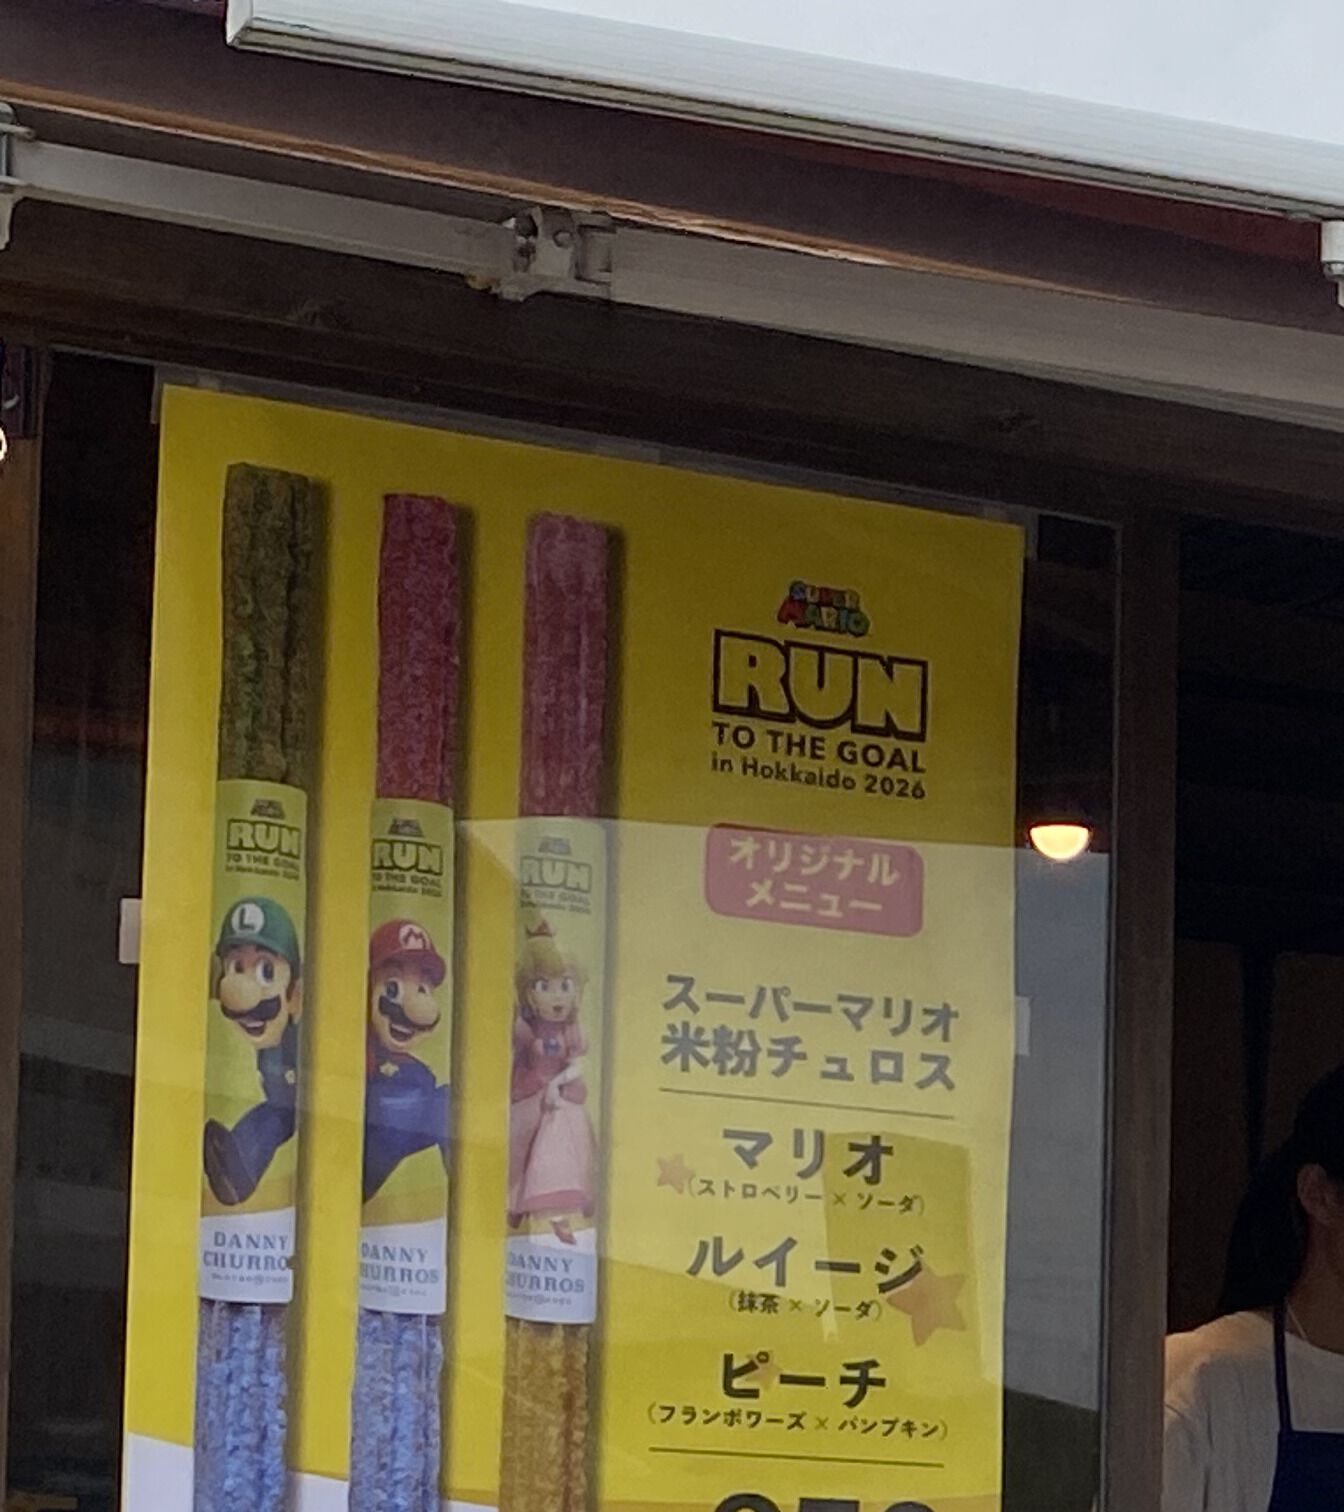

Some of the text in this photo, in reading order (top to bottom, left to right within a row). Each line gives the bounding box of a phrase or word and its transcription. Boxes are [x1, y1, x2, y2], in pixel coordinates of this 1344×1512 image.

[777, 598, 871, 637] MARIO
[789, 580, 861, 609] SUPER
[712, 629, 929, 743] RUN
[712, 720, 926, 774] TO THE GOAL
[711, 751, 925, 800] in Hokkaido 2026
[227, 819, 300, 859] RUN
[372, 839, 443, 876] RUN
[729, 836, 897, 887] オリジナル
[745, 880, 883, 918] メニュー
[661, 974, 959, 1043] スーパーマリオ
[660, 1021, 955, 1091] 米粉チュロス
[722, 1128, 894, 1185] マリオ
[214, 1231, 289, 1250] DANNY
[686, 1236, 923, 1294] ルイージ
[722, 1351, 886, 1408] ピーチ
